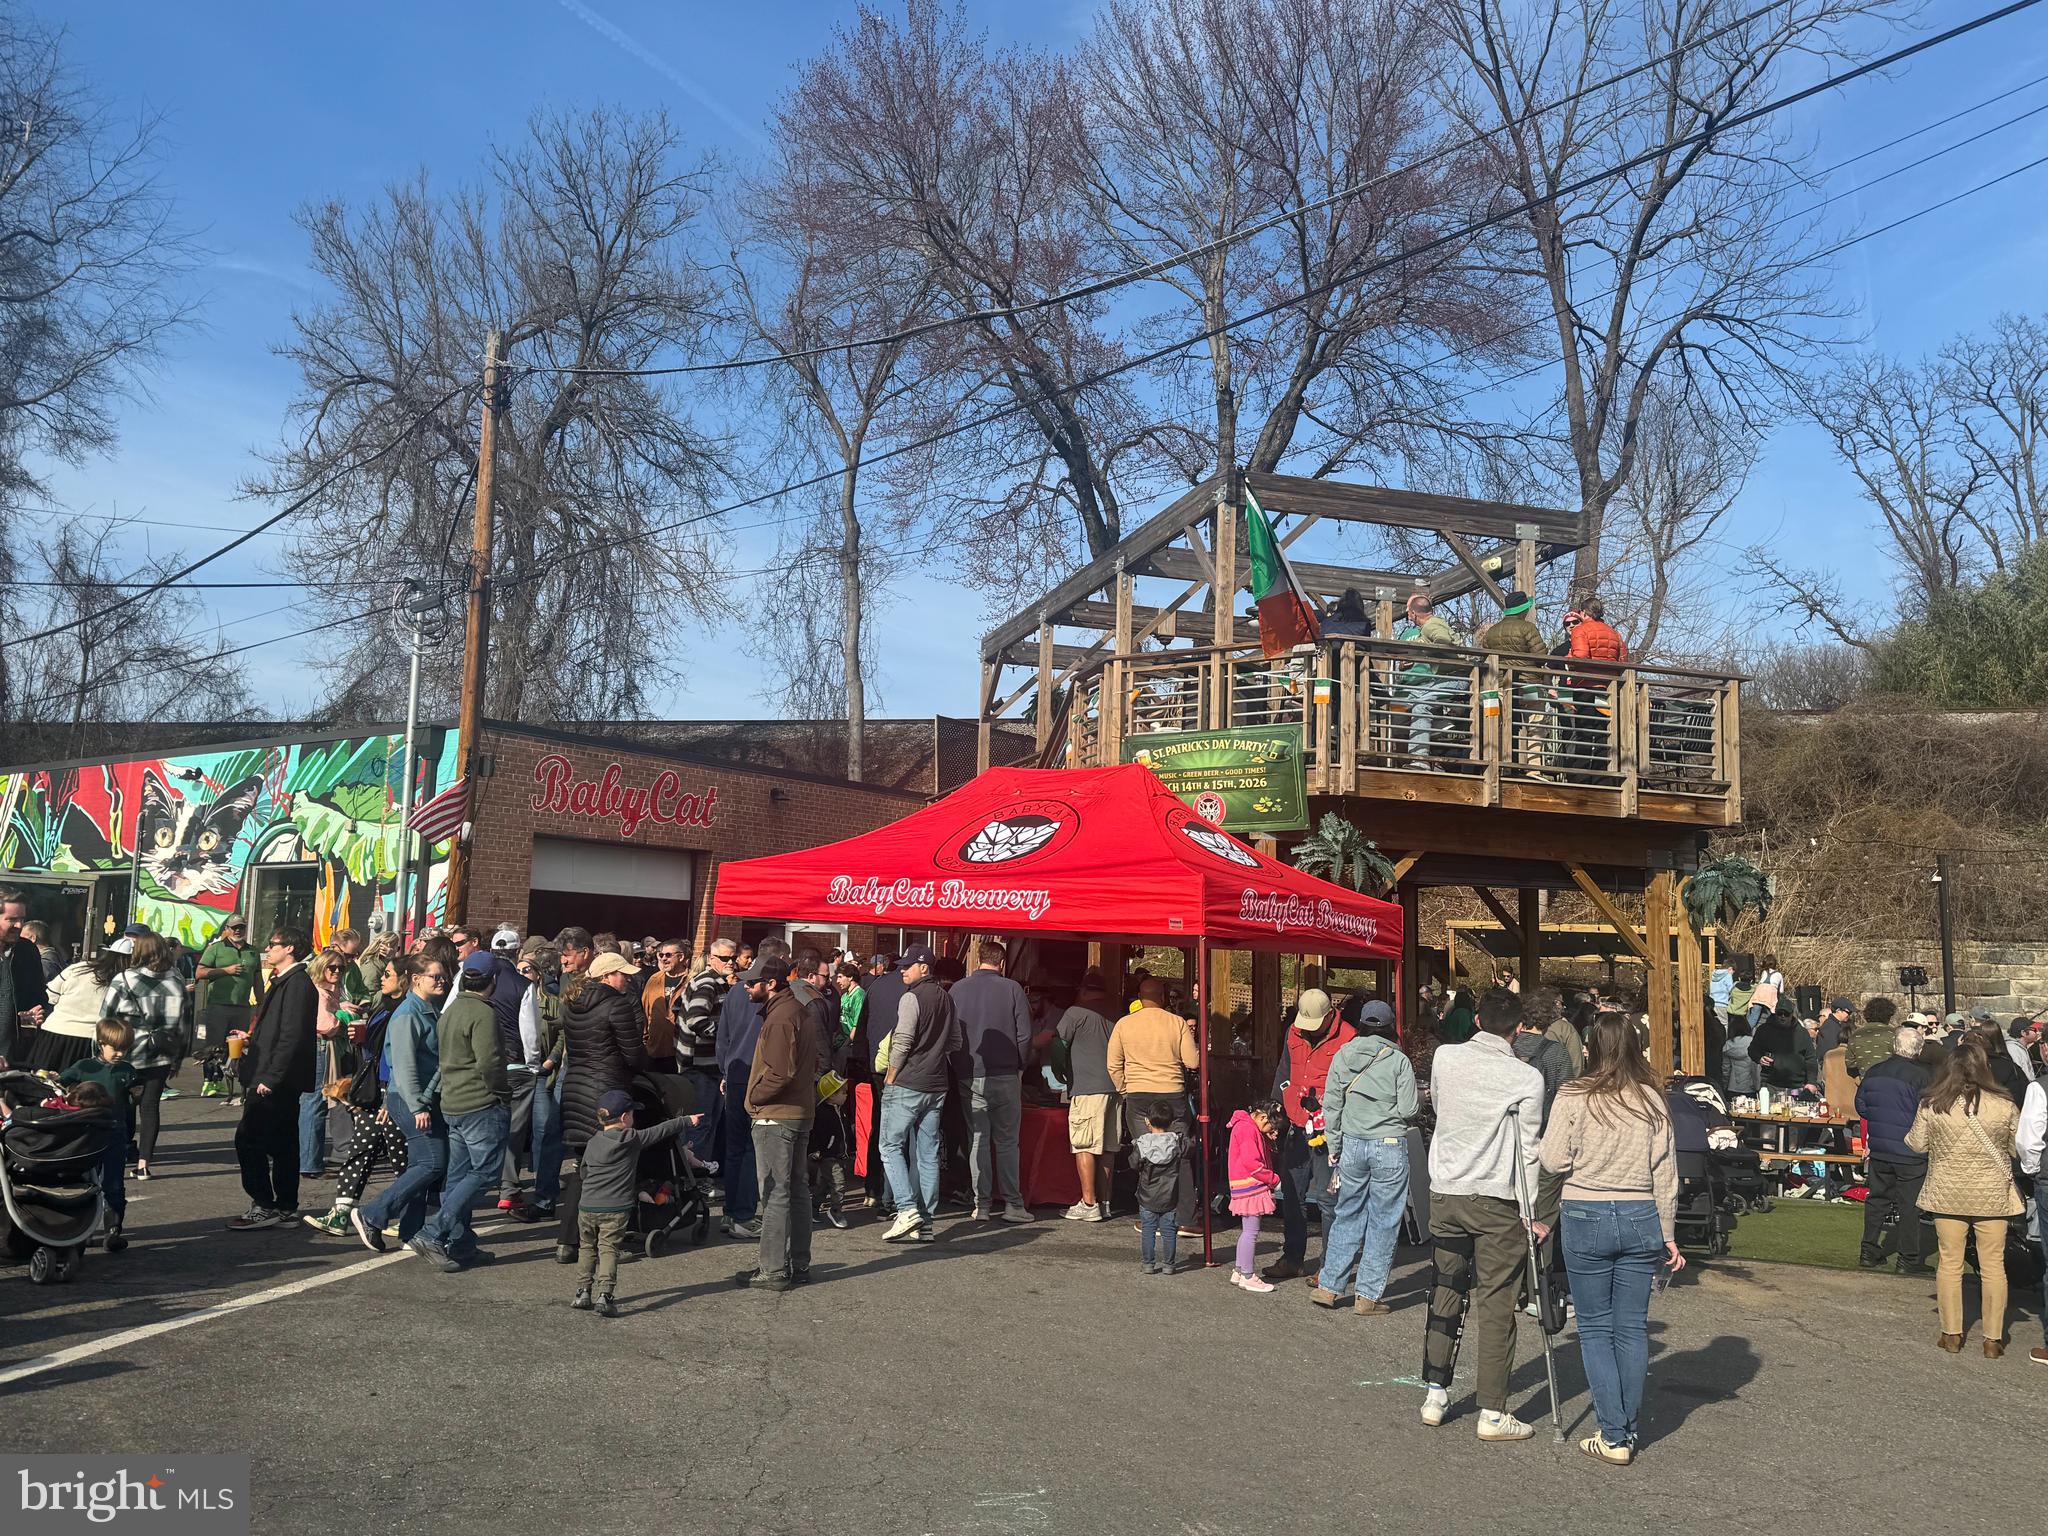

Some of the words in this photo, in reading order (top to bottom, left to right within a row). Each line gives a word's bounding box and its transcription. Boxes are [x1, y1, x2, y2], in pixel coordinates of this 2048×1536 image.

[1152, 748, 1165, 760] ST.
[1166, 739, 1209, 756] PATRICK'S
[1212, 739, 1231, 750] DAY
[1233, 739, 1268, 753] PARTY!
[1245, 766, 1267, 774] TIMES!
[1181, 781, 1201, 791] 14TH
[1203, 781, 1210, 789] &
[1212, 779, 1236, 790] 15TH,
[1238, 778, 1267, 788] 2026
[530, 754, 719, 838] BabyCat
[993, 802, 1073, 820] BABYCAT
[826, 875, 935, 914] BabyCat
[937, 879, 1051, 921] Brewery
[1239, 887, 1314, 932] BabyCat
[1316, 899, 1378, 946] Brewery
